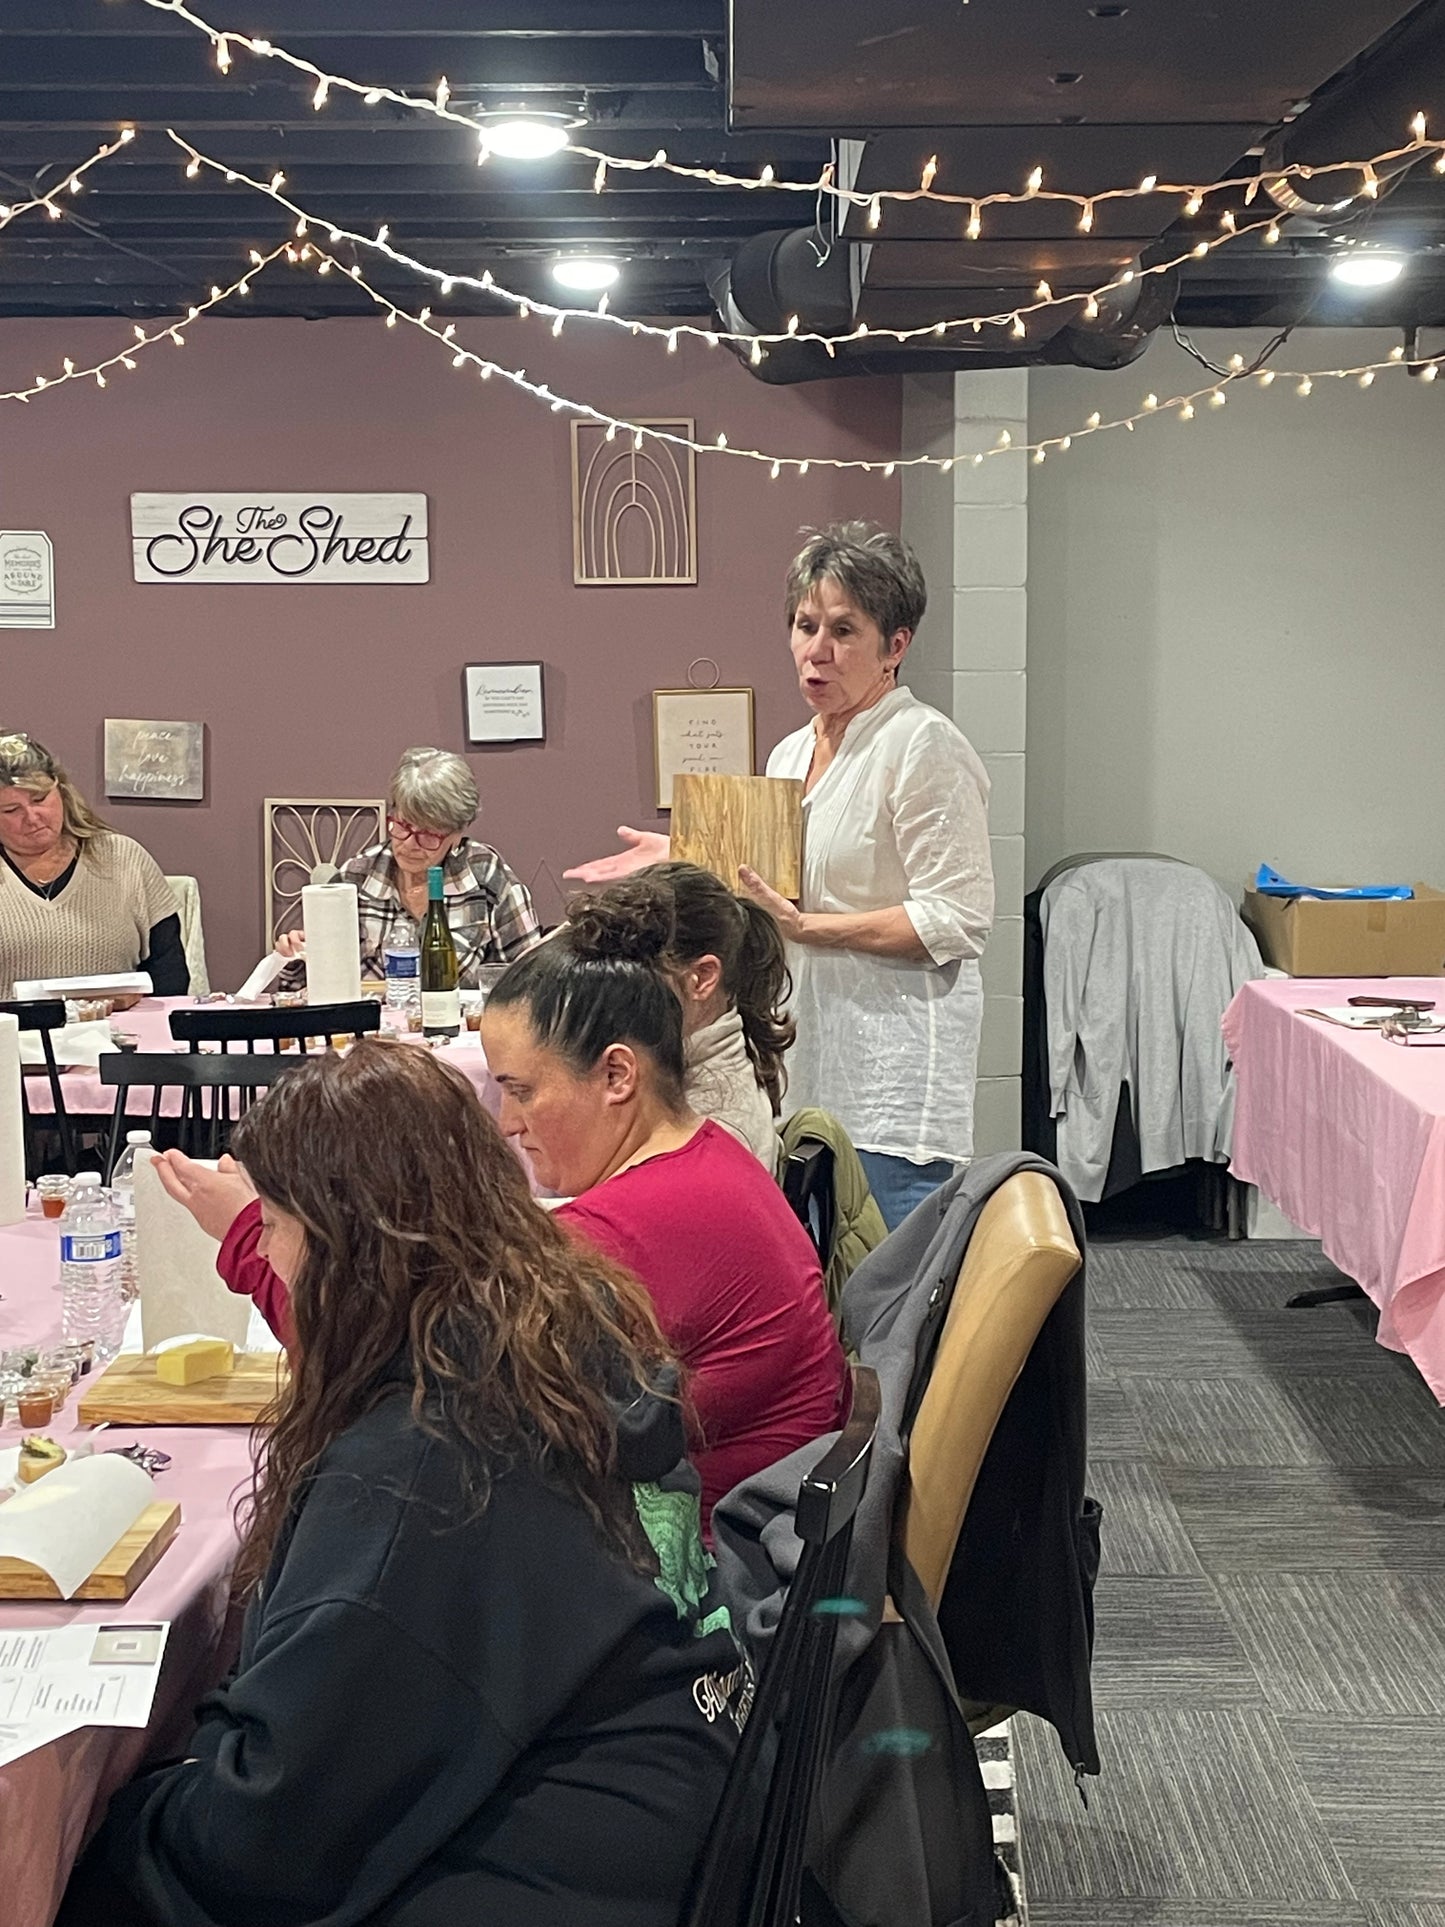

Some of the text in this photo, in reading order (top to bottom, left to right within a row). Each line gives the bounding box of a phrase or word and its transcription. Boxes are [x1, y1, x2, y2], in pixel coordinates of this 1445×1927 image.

[147, 505, 412, 576] She Shed
[236, 505, 287, 534] The
